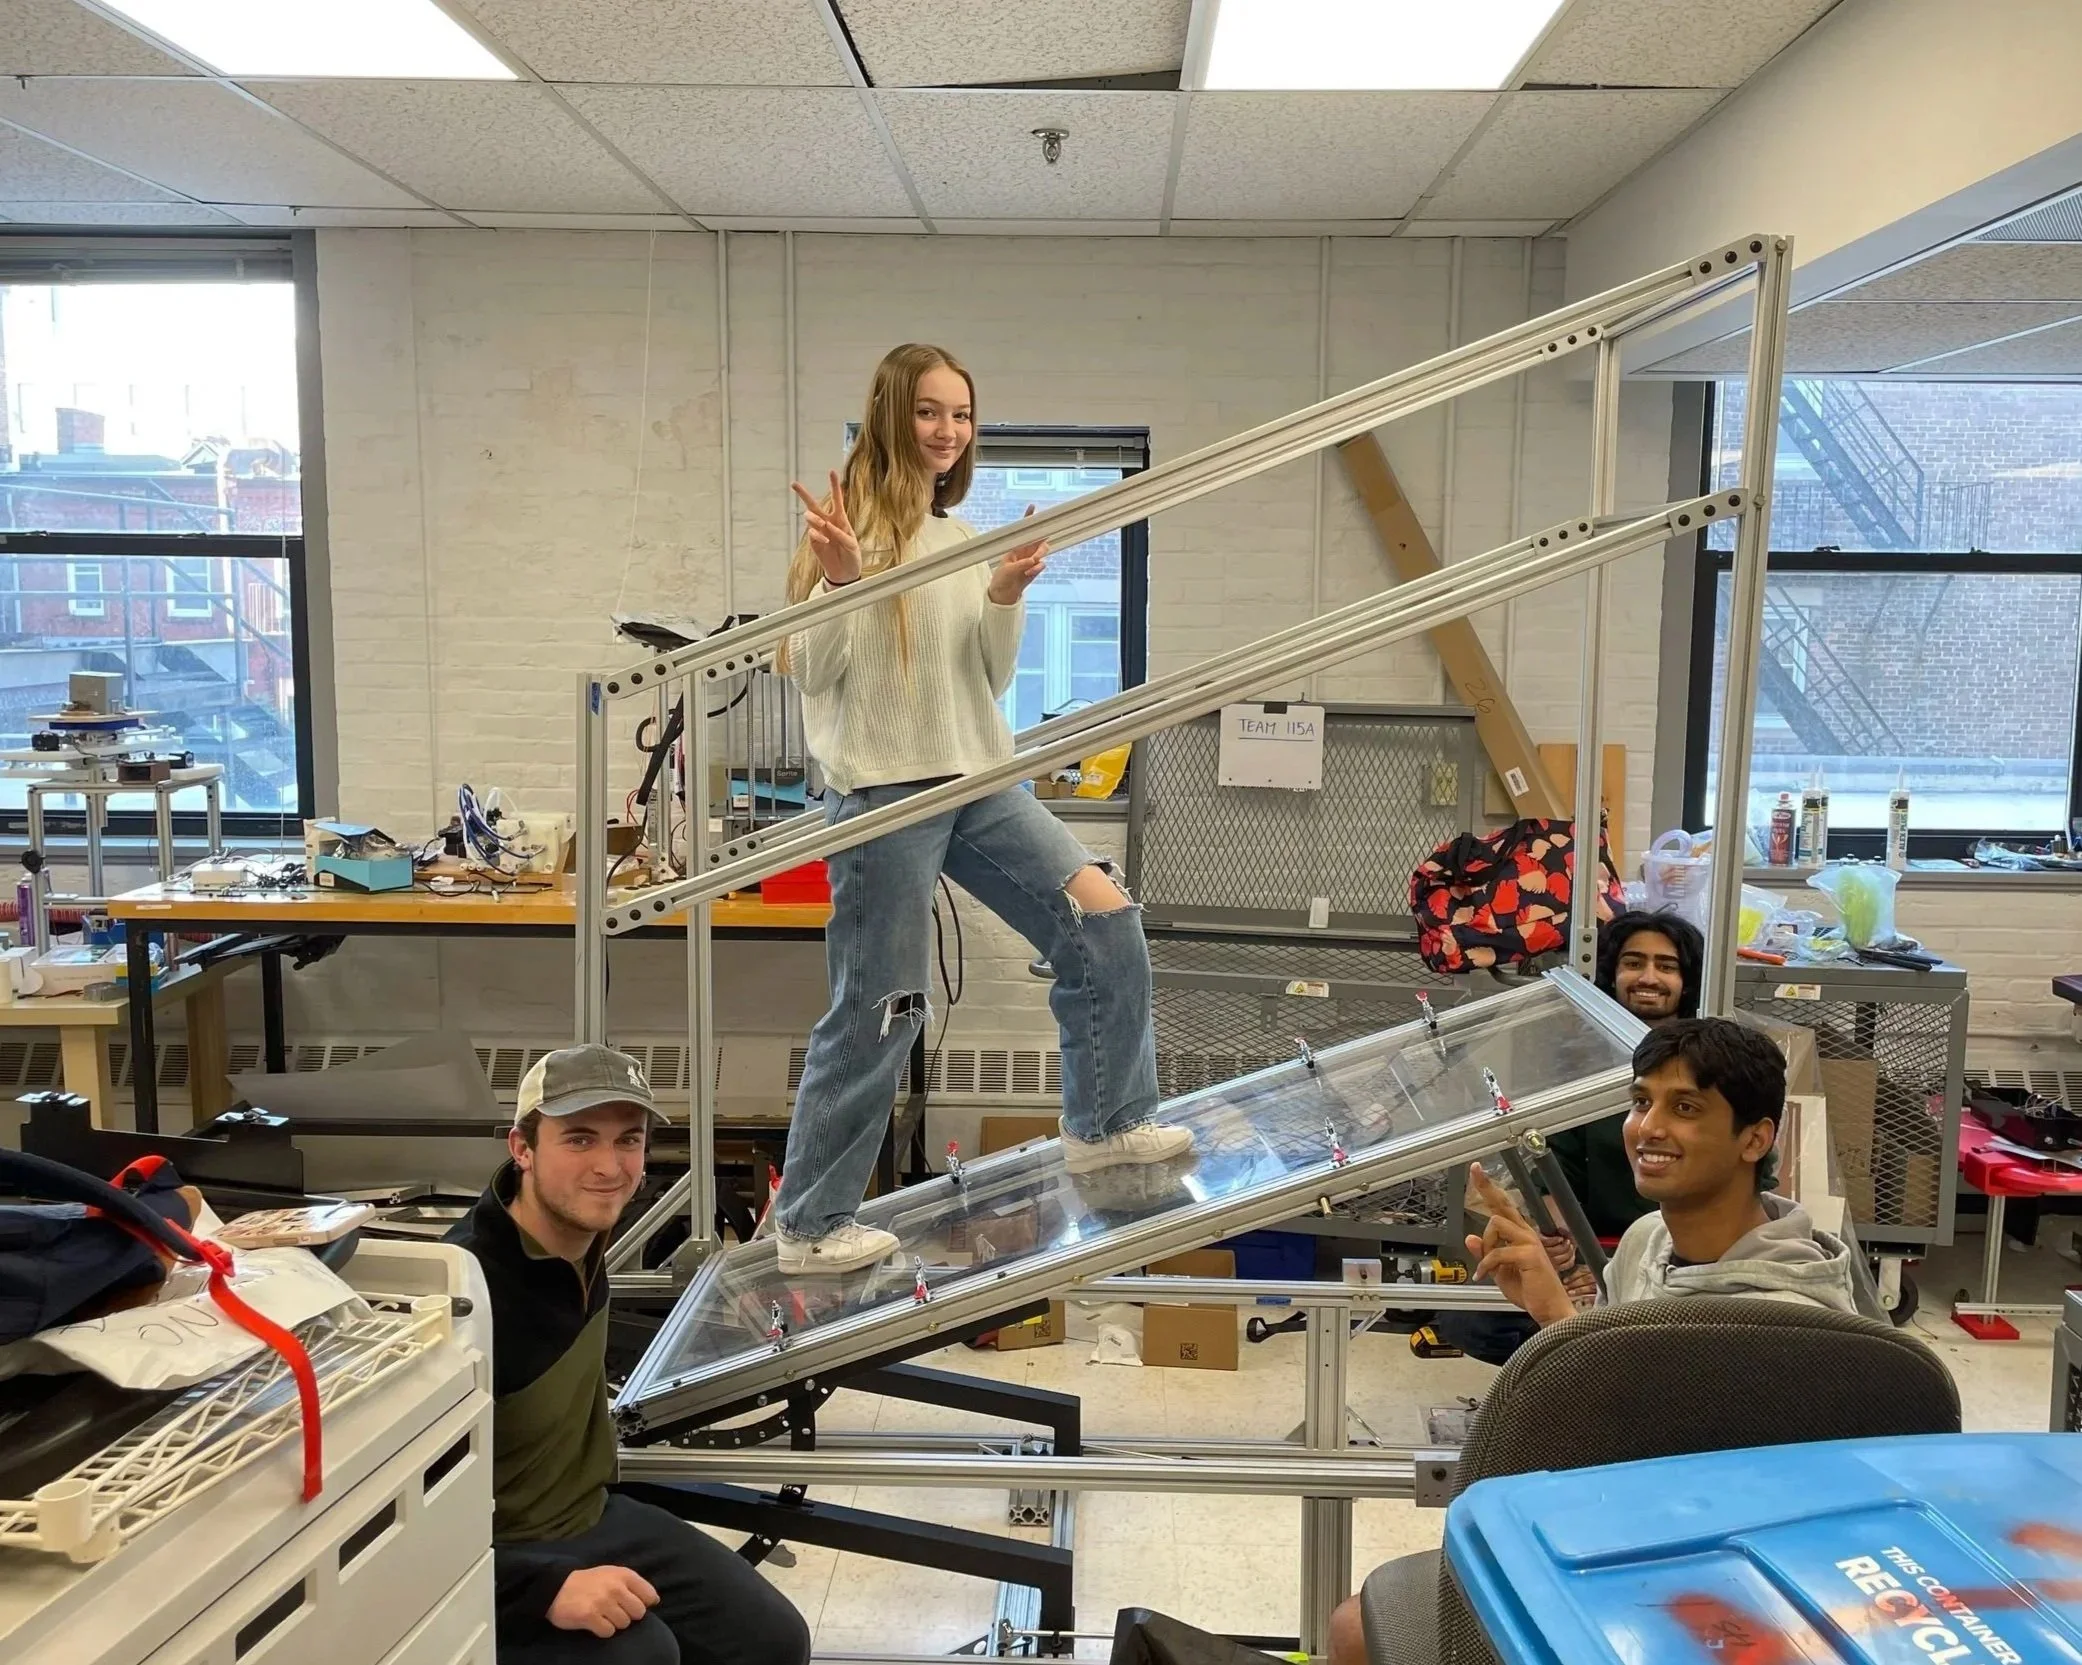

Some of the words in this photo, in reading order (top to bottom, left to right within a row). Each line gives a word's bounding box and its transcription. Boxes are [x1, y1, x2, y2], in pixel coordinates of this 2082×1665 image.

[1238, 718, 1277, 736] TEAM
[1286, 721, 1315, 736] 115A
[1835, 1555, 1980, 1665] RECYCL
[1881, 1546, 1925, 1576] THIS
[1916, 1575, 2022, 1665] CONTAINER
